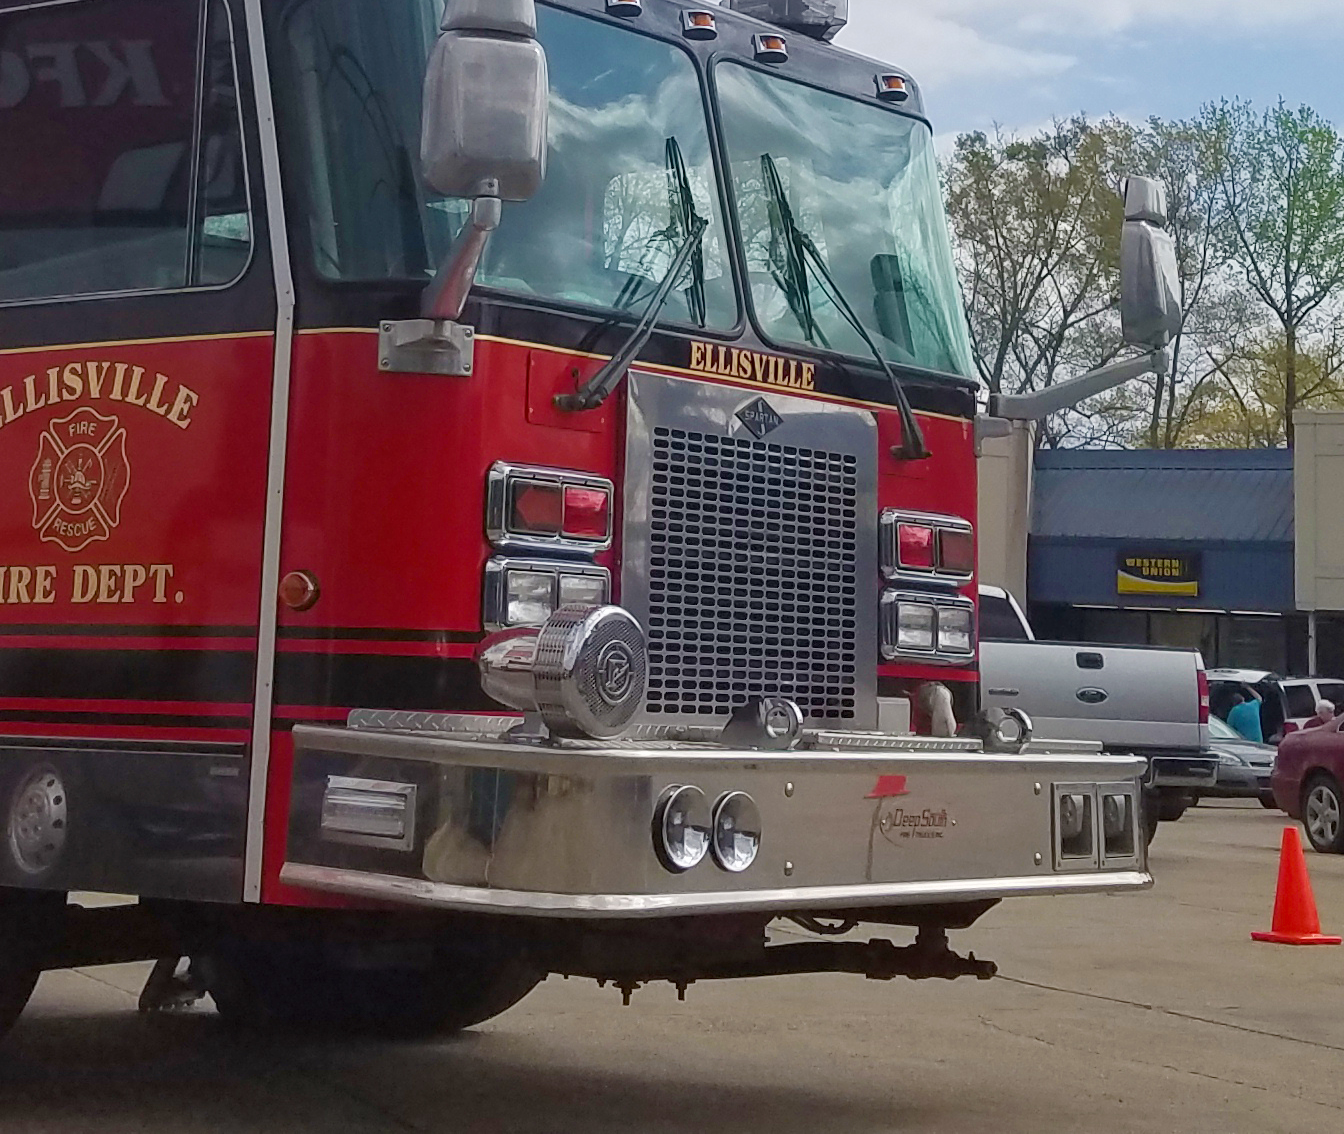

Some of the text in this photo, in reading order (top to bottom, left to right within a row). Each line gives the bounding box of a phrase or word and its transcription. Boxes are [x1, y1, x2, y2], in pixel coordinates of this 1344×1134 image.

[690, 341, 815, 390] ELLISVILLE
[68, 421, 97, 437] FIRE
[52, 516, 97, 537] RESCUE
[1125, 558, 1179, 568] WESTERN
[1142, 567, 1179, 577] UNION
[70, 564, 185, 604] DEPT.
